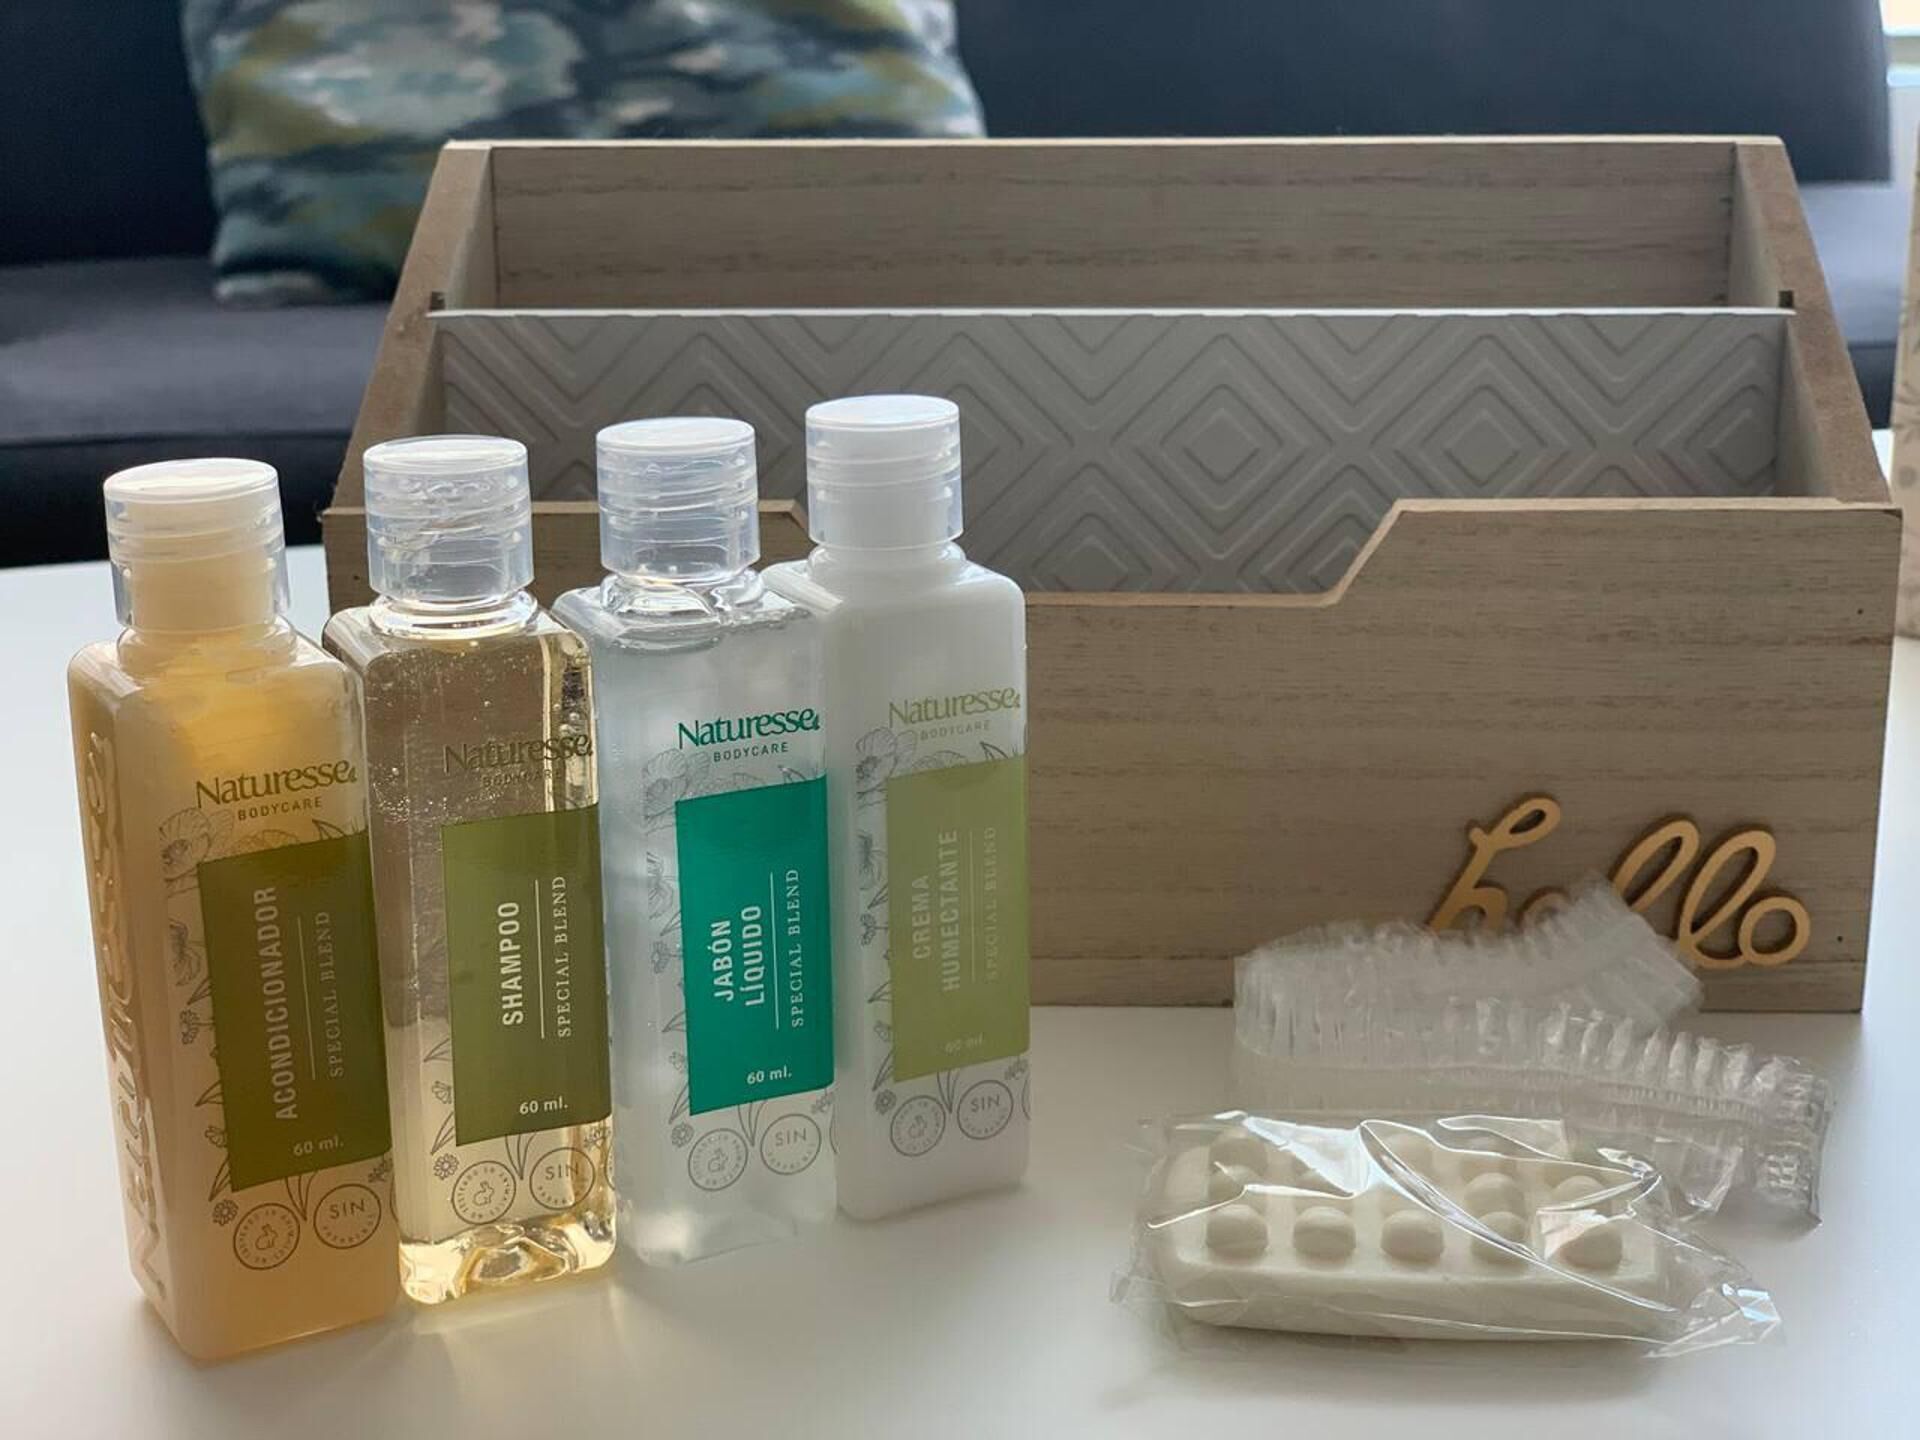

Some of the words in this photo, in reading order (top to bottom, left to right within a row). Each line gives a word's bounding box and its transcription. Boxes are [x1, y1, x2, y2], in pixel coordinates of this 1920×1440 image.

[678, 707, 820, 751] Naturesse
[888, 687, 1020, 729] Naturesse
[919, 719, 991, 741] BODYCARE
[443, 734, 594, 774] Naturesse
[713, 741, 790, 762] BODYCARE
[195, 759, 357, 809] Naturesse
[237, 796, 323, 822] BODYCARE
[553, 875, 568, 942] BLEND
[786, 867, 801, 936] BLEND
[911, 874, 931, 960] CREMA
[938, 829, 961, 993] HUMECTANTE
[314, 910, 334, 982] BLEND
[496, 901, 524, 1026] SHAMPOO
[712, 918, 735, 1002] JABÓN
[739, 904, 765, 1007] LÍQUIDO
[253, 886, 298, 1121] ACONDICIONADOR
[556, 949, 572, 1038] SPECIAL
[790, 943, 804, 1028] SPECIAL
[323, 988, 344, 1078] SPECIAL
[746, 1069, 767, 1086] 60
[769, 1065, 793, 1082] ml.
[518, 1100, 541, 1116] 60
[543, 1096, 569, 1113] ml.
[969, 1093, 1002, 1113] SIN
[293, 1142, 313, 1157] 60
[776, 1127, 808, 1147] SIN
[544, 1161, 580, 1181] SIN
[328, 1198, 365, 1221] SIN
